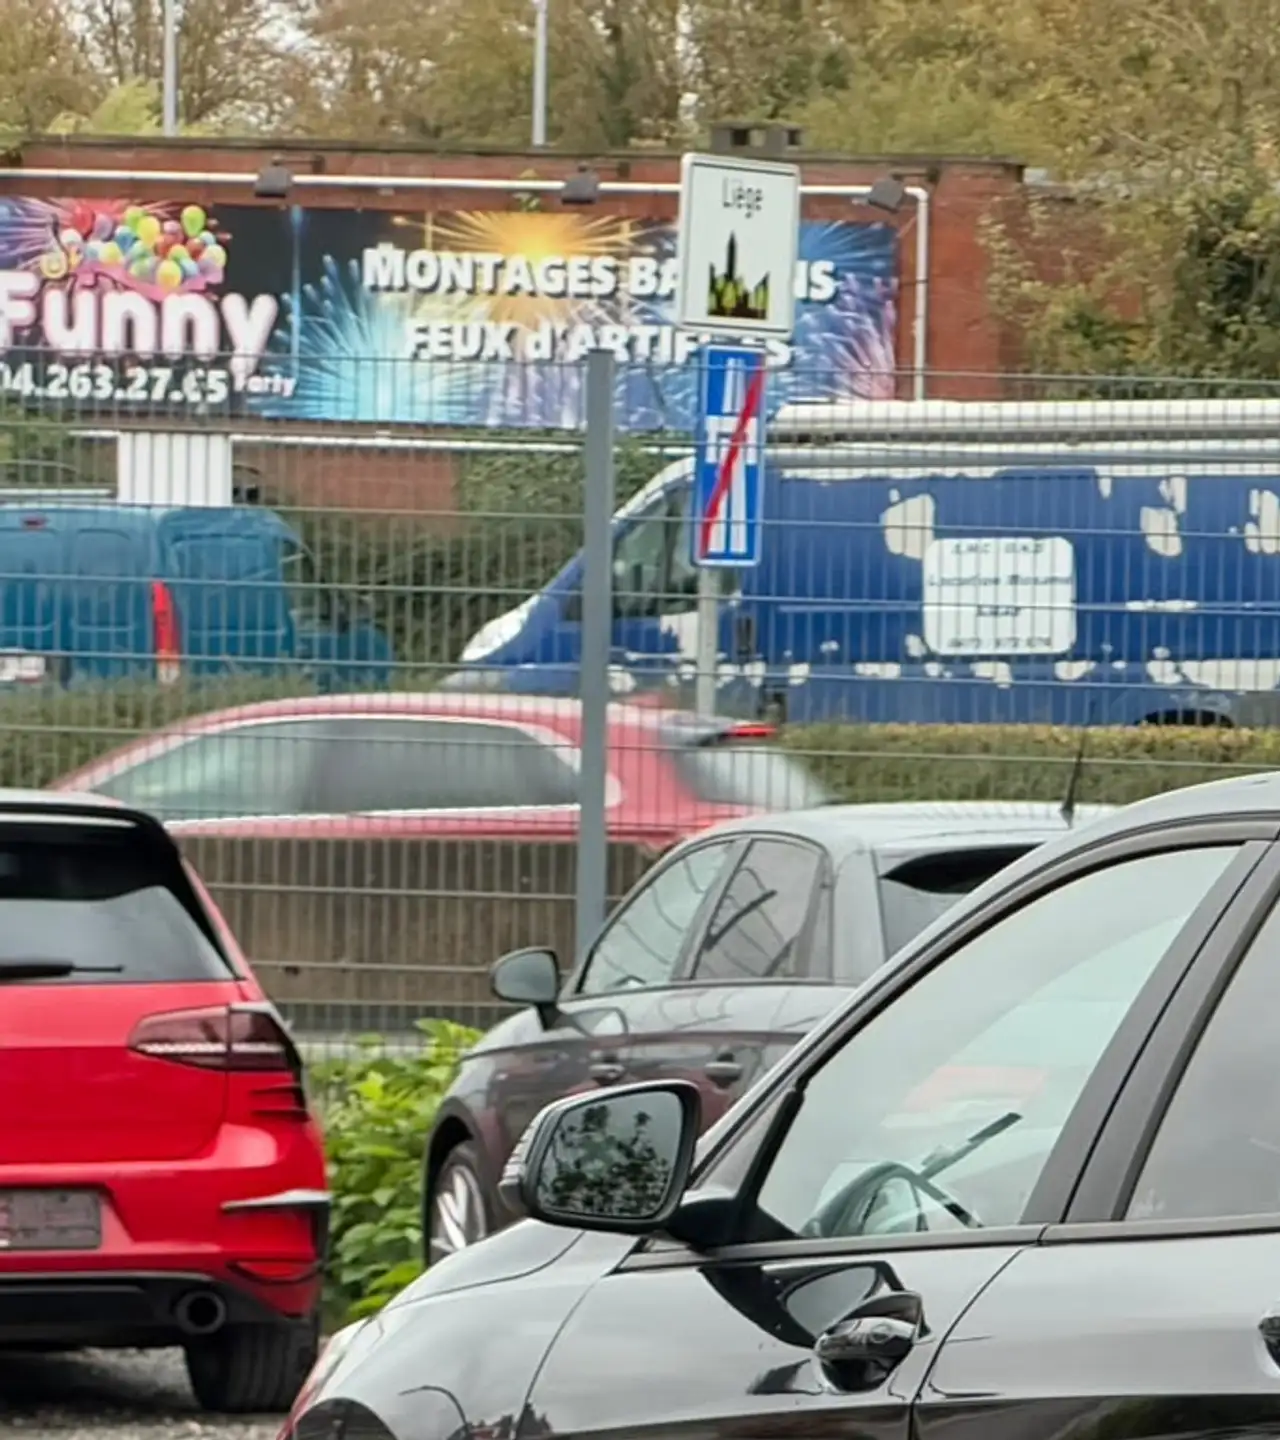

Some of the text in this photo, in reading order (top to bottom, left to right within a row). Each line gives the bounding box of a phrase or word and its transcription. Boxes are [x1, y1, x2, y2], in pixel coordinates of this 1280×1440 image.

[362, 246, 618, 297] MONTAGES
[0, 270, 279, 378] Funny
[405, 318, 515, 361] FEUX
